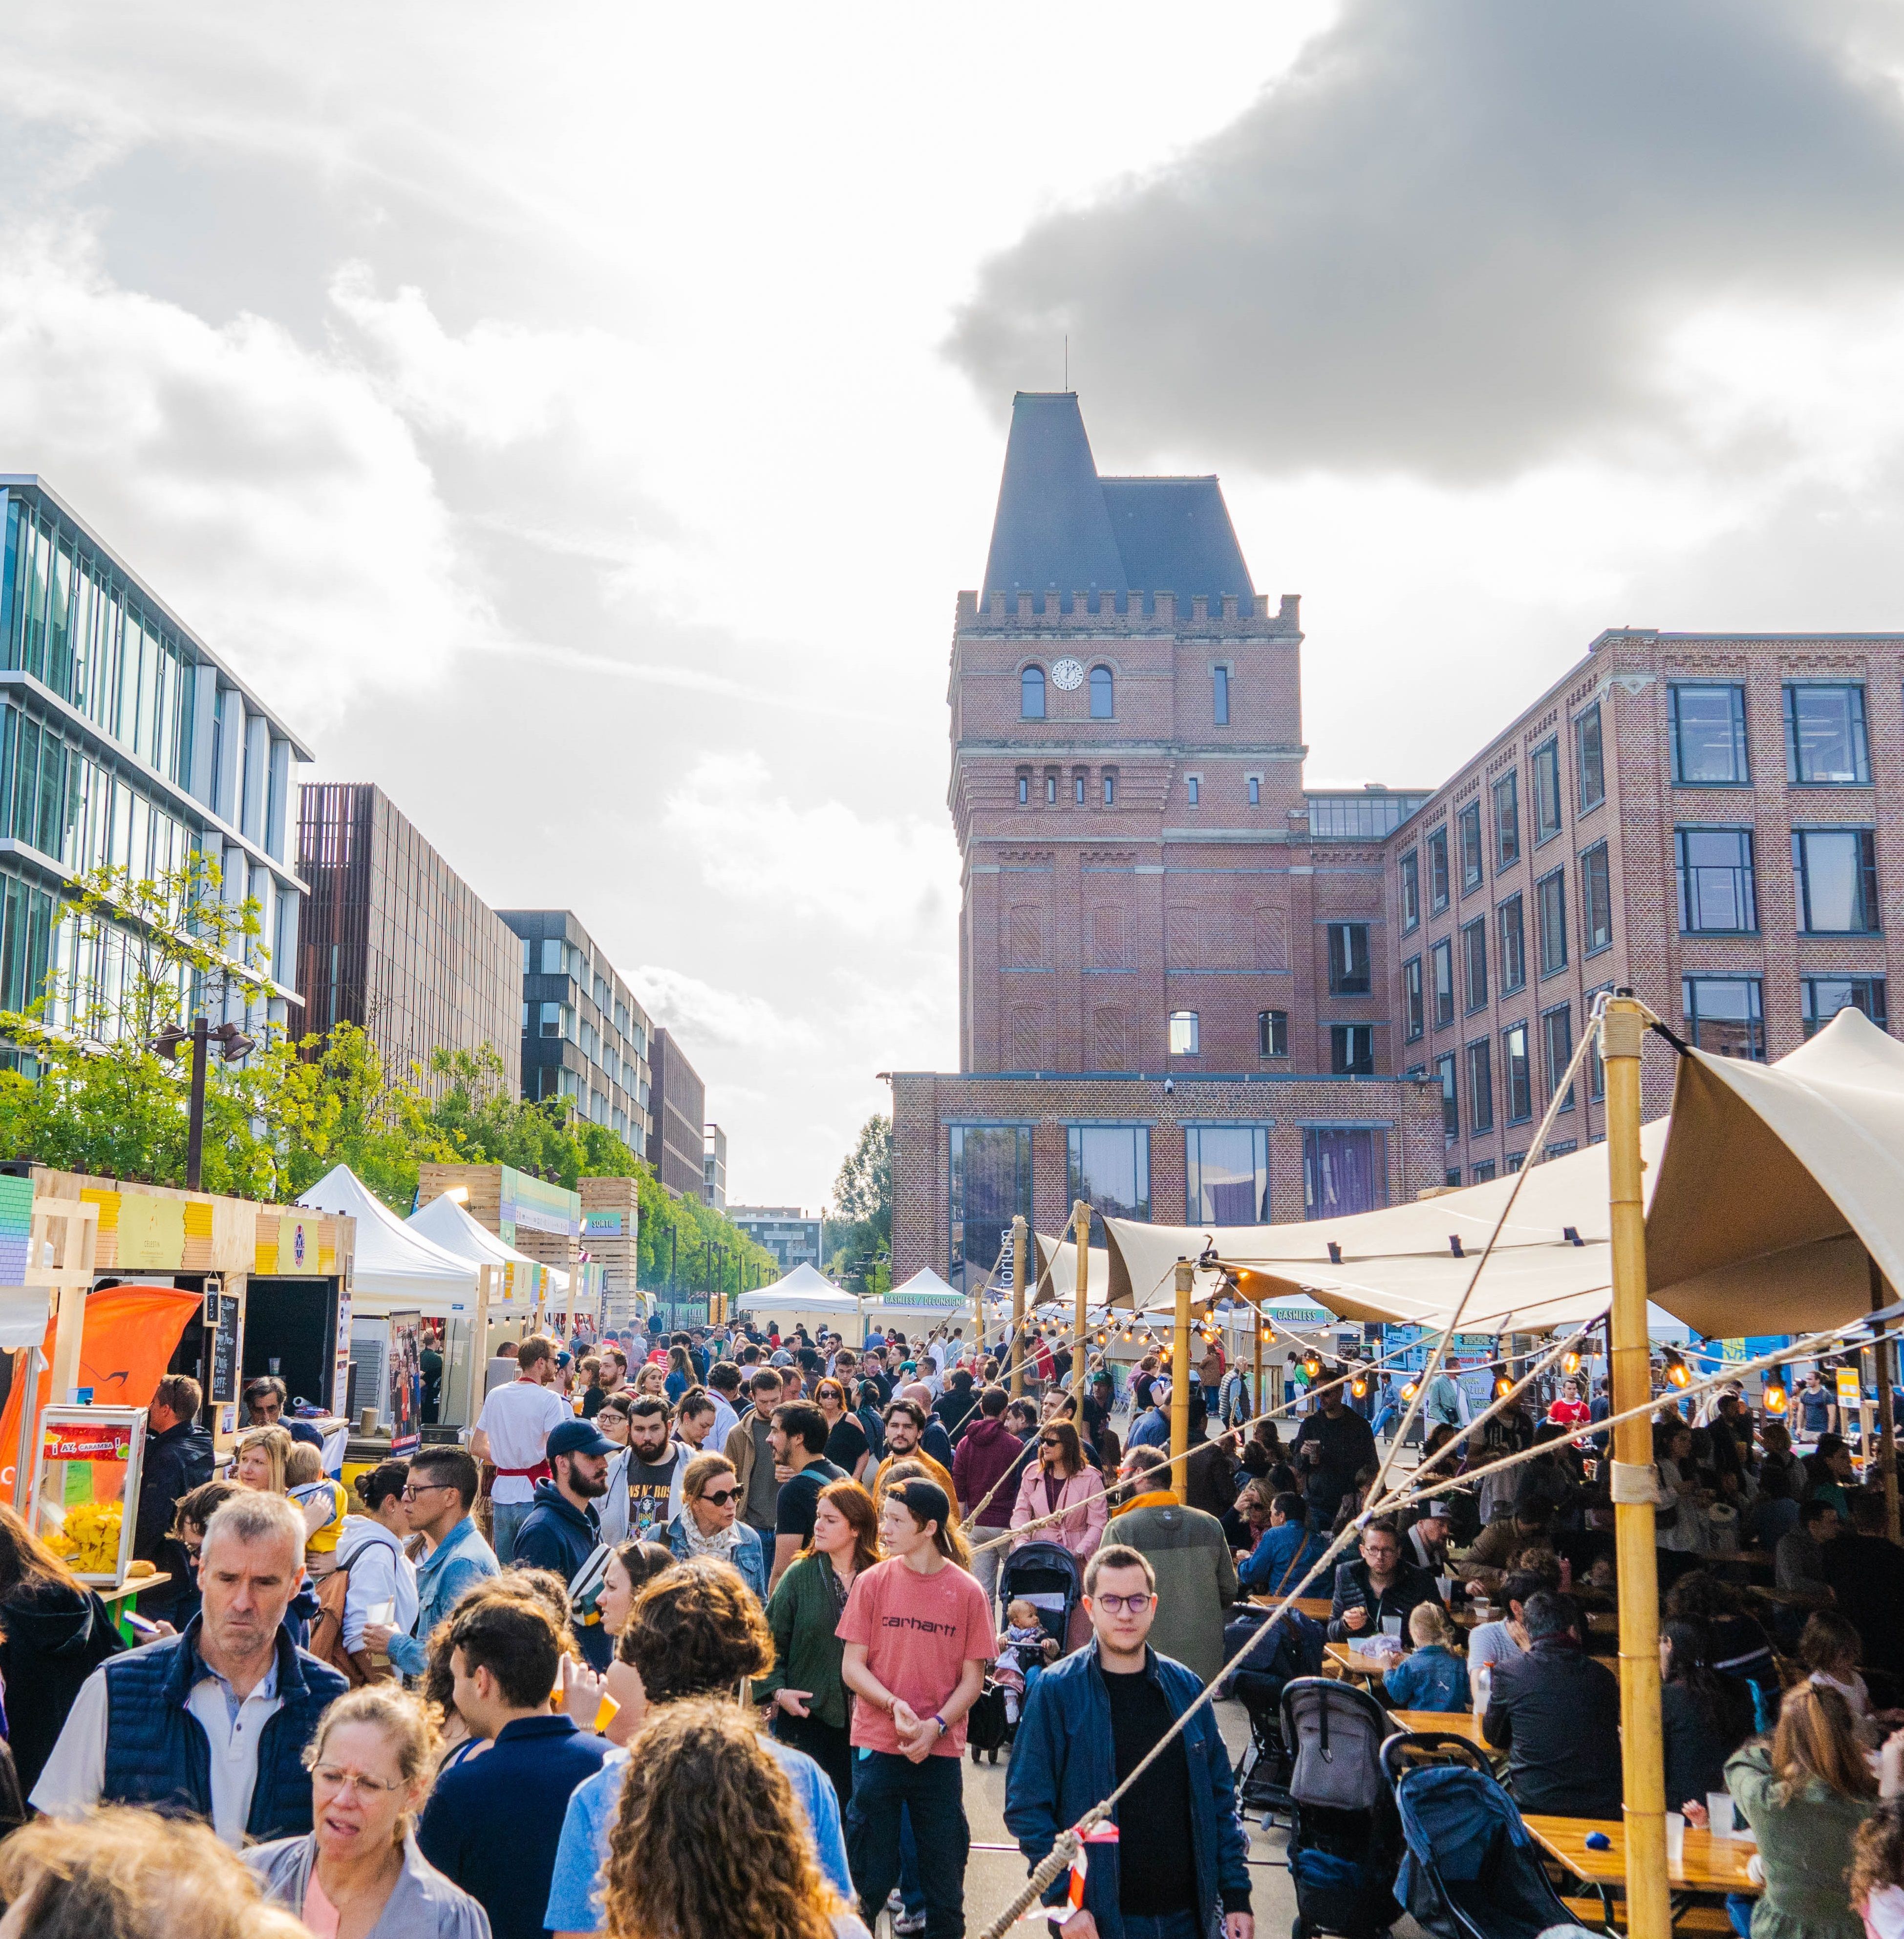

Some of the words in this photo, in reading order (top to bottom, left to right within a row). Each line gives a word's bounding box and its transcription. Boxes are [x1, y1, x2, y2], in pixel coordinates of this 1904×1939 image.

[592, 1219, 614, 1228] SORTIE
[885, 1296, 916, 1305] CASHLESS
[666, 1308, 683, 1317] LILE
[688, 1308, 704, 1317] LILLE
[1277, 1310, 1316, 1321] CASHLESS
[628, 1485, 640, 1498] NS
[882, 1616, 957, 1637] carhartt
